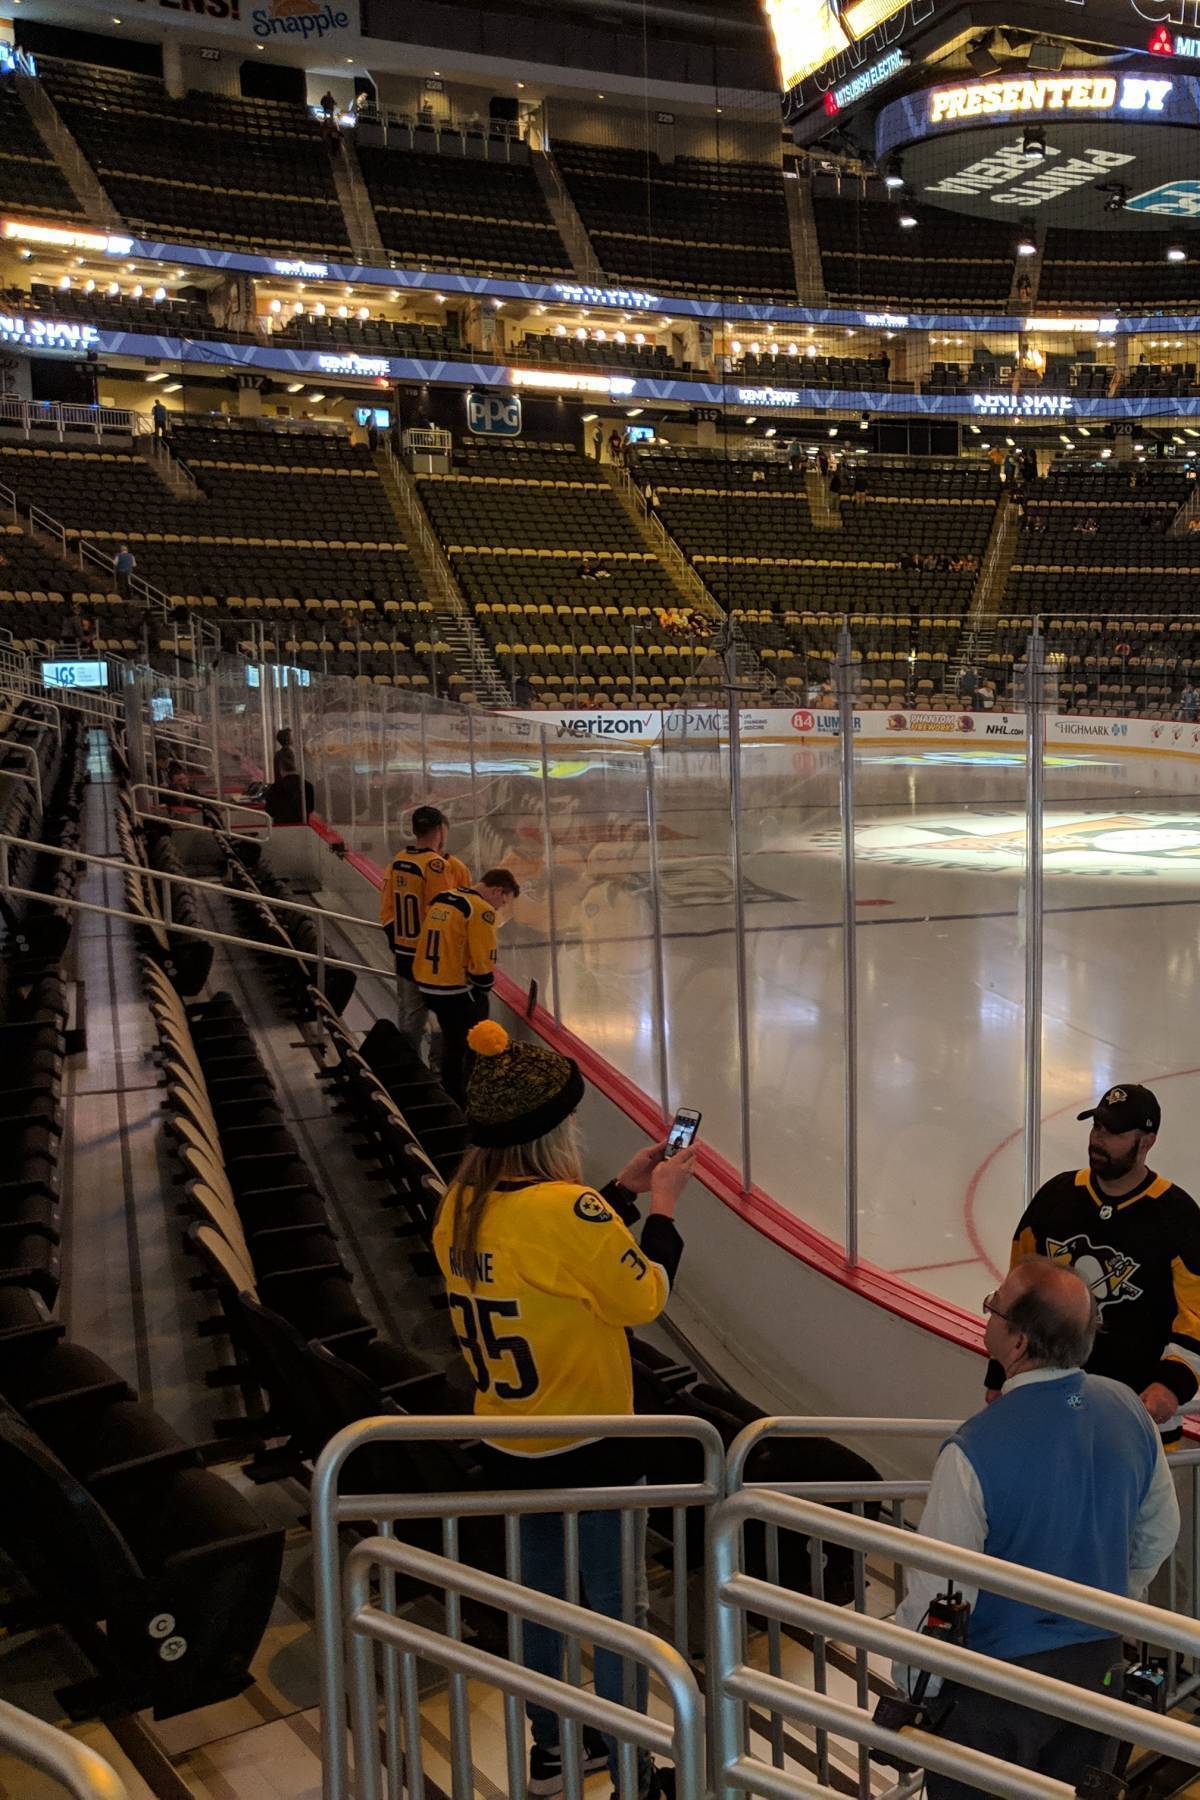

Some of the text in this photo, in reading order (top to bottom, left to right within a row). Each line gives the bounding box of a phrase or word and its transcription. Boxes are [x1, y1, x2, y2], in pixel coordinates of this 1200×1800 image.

[253, 5, 349, 39] Snapple
[836, 50, 904, 107] MITSUBISHI ELECTRIC
[931, 78, 1173, 123] PRESENTED BY
[990, 149, 1137, 206] PAINTS
[471, 400, 517, 430] PPG
[55, 667, 75, 684] IGS
[561, 715, 643, 734] verizon
[794, 715, 860, 729] 84 LUMR
[910, 714, 955, 724] PHANTOM
[1056, 721, 1109, 736] HIGHMARK
[395, 892, 420, 938] 10
[426, 930, 440, 975] 4
[450, 1292, 539, 1399] 35
[157, 1619, 168, 1632] C
